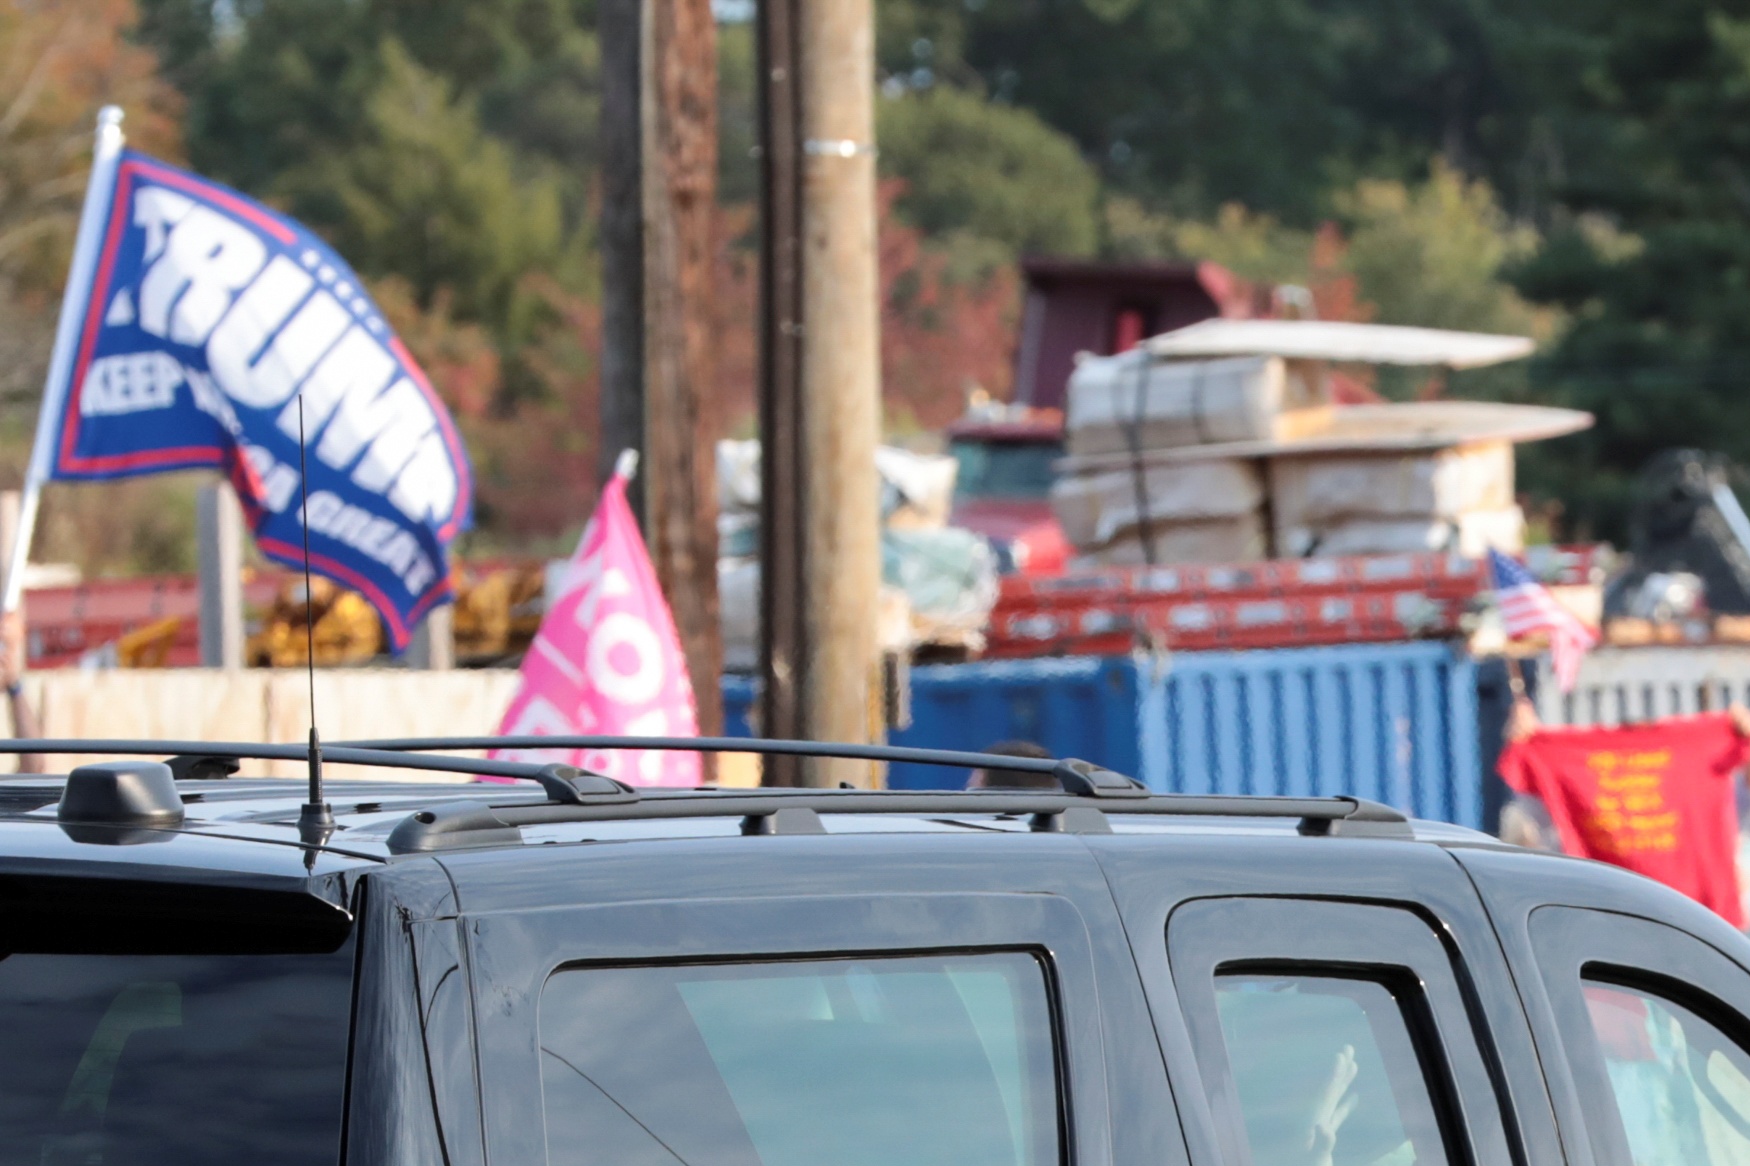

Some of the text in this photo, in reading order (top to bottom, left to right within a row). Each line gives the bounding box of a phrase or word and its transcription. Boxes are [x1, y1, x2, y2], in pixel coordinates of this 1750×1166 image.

[79, 350, 186, 417] KEEP
[105, 185, 459, 524] TRUMP
[295, 490, 437, 598] GREAT
